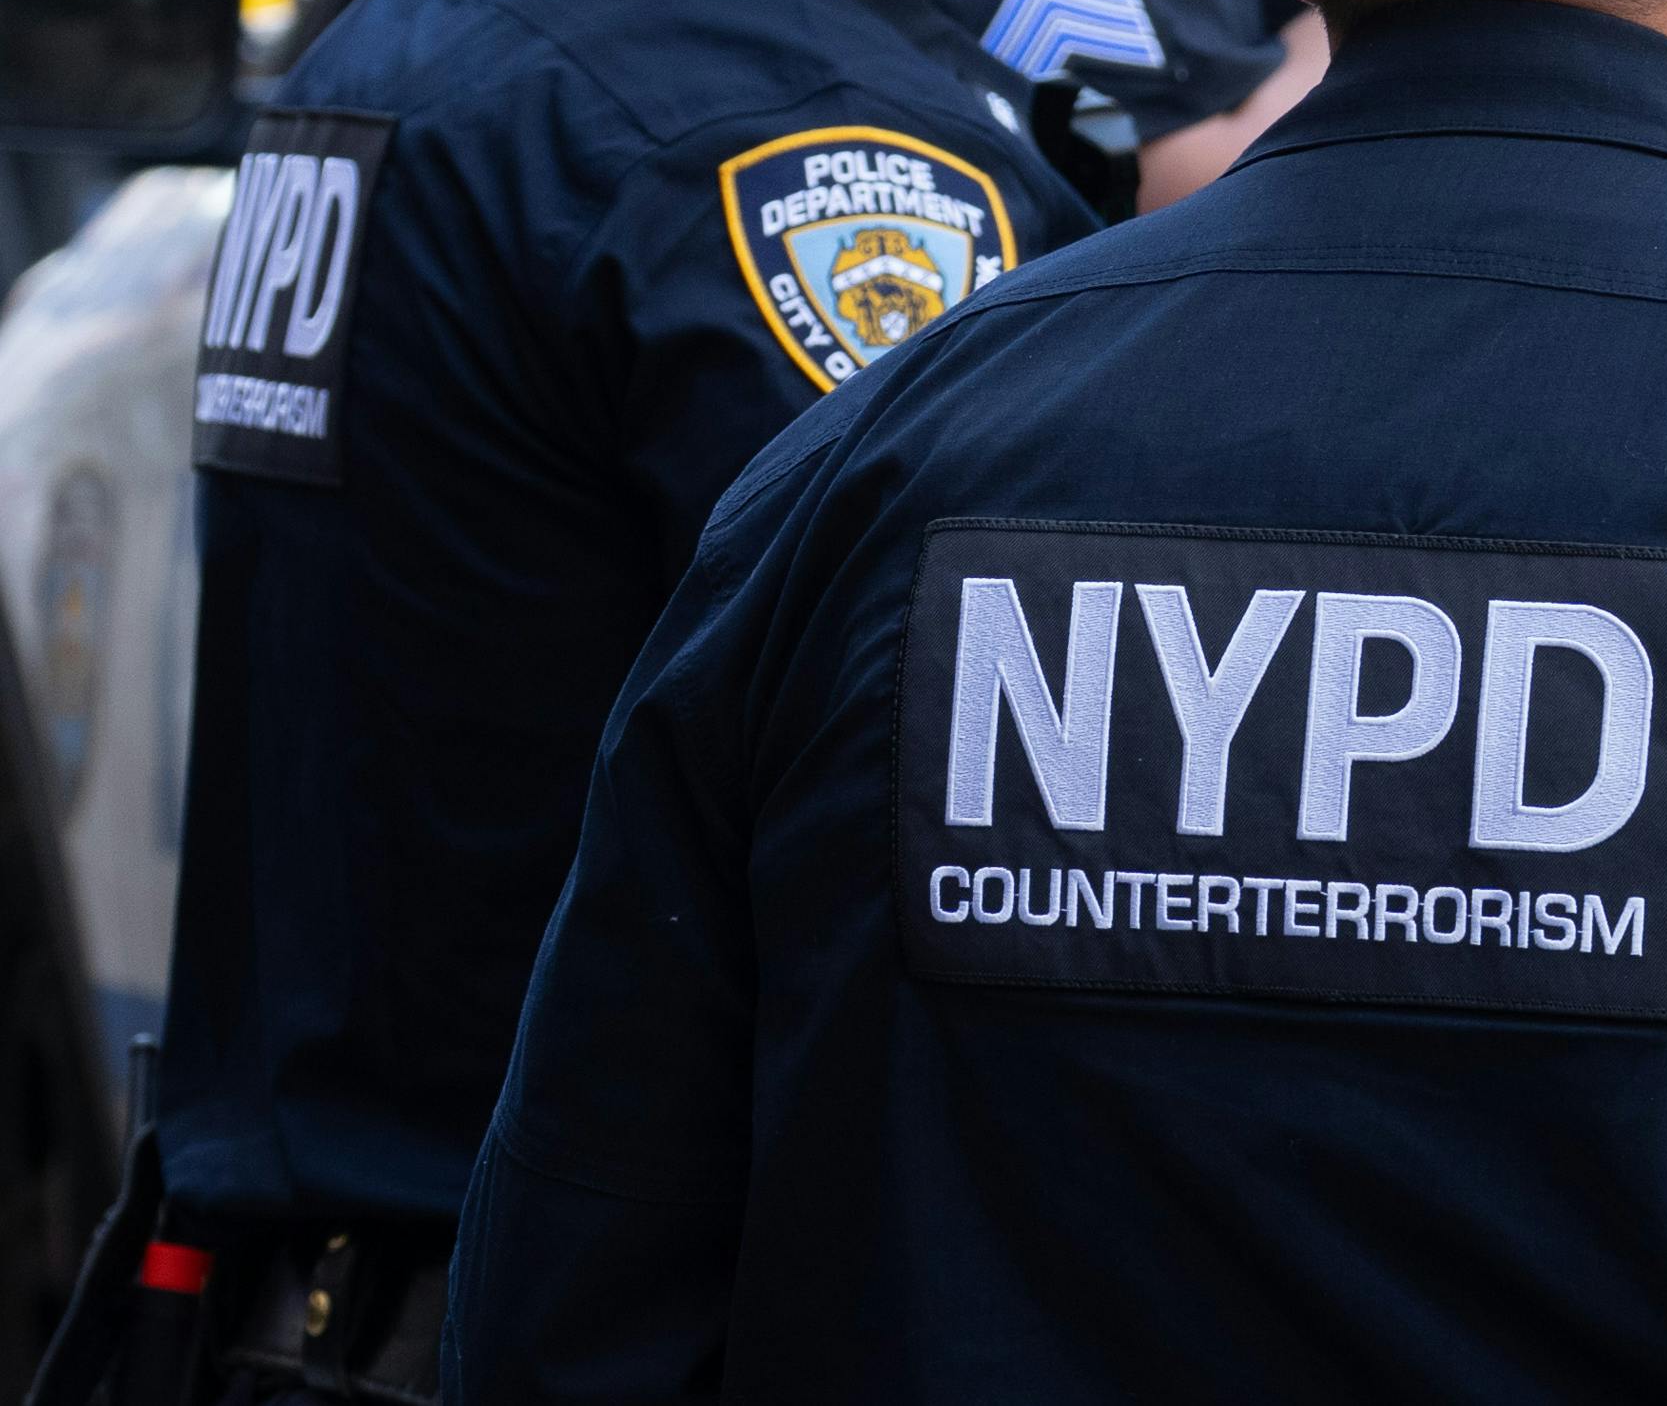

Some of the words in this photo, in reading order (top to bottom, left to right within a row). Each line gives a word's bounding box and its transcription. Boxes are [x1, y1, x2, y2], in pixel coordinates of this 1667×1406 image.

[760, 180, 985, 237] DEPARTMENT
[803, 150, 935, 192] POLICE
[769, 272, 835, 347] CITY
[824, 350, 860, 381] O
[945, 578, 1654, 852] NYPD
[930, 865, 1645, 957] COUNTERTERRORISM
